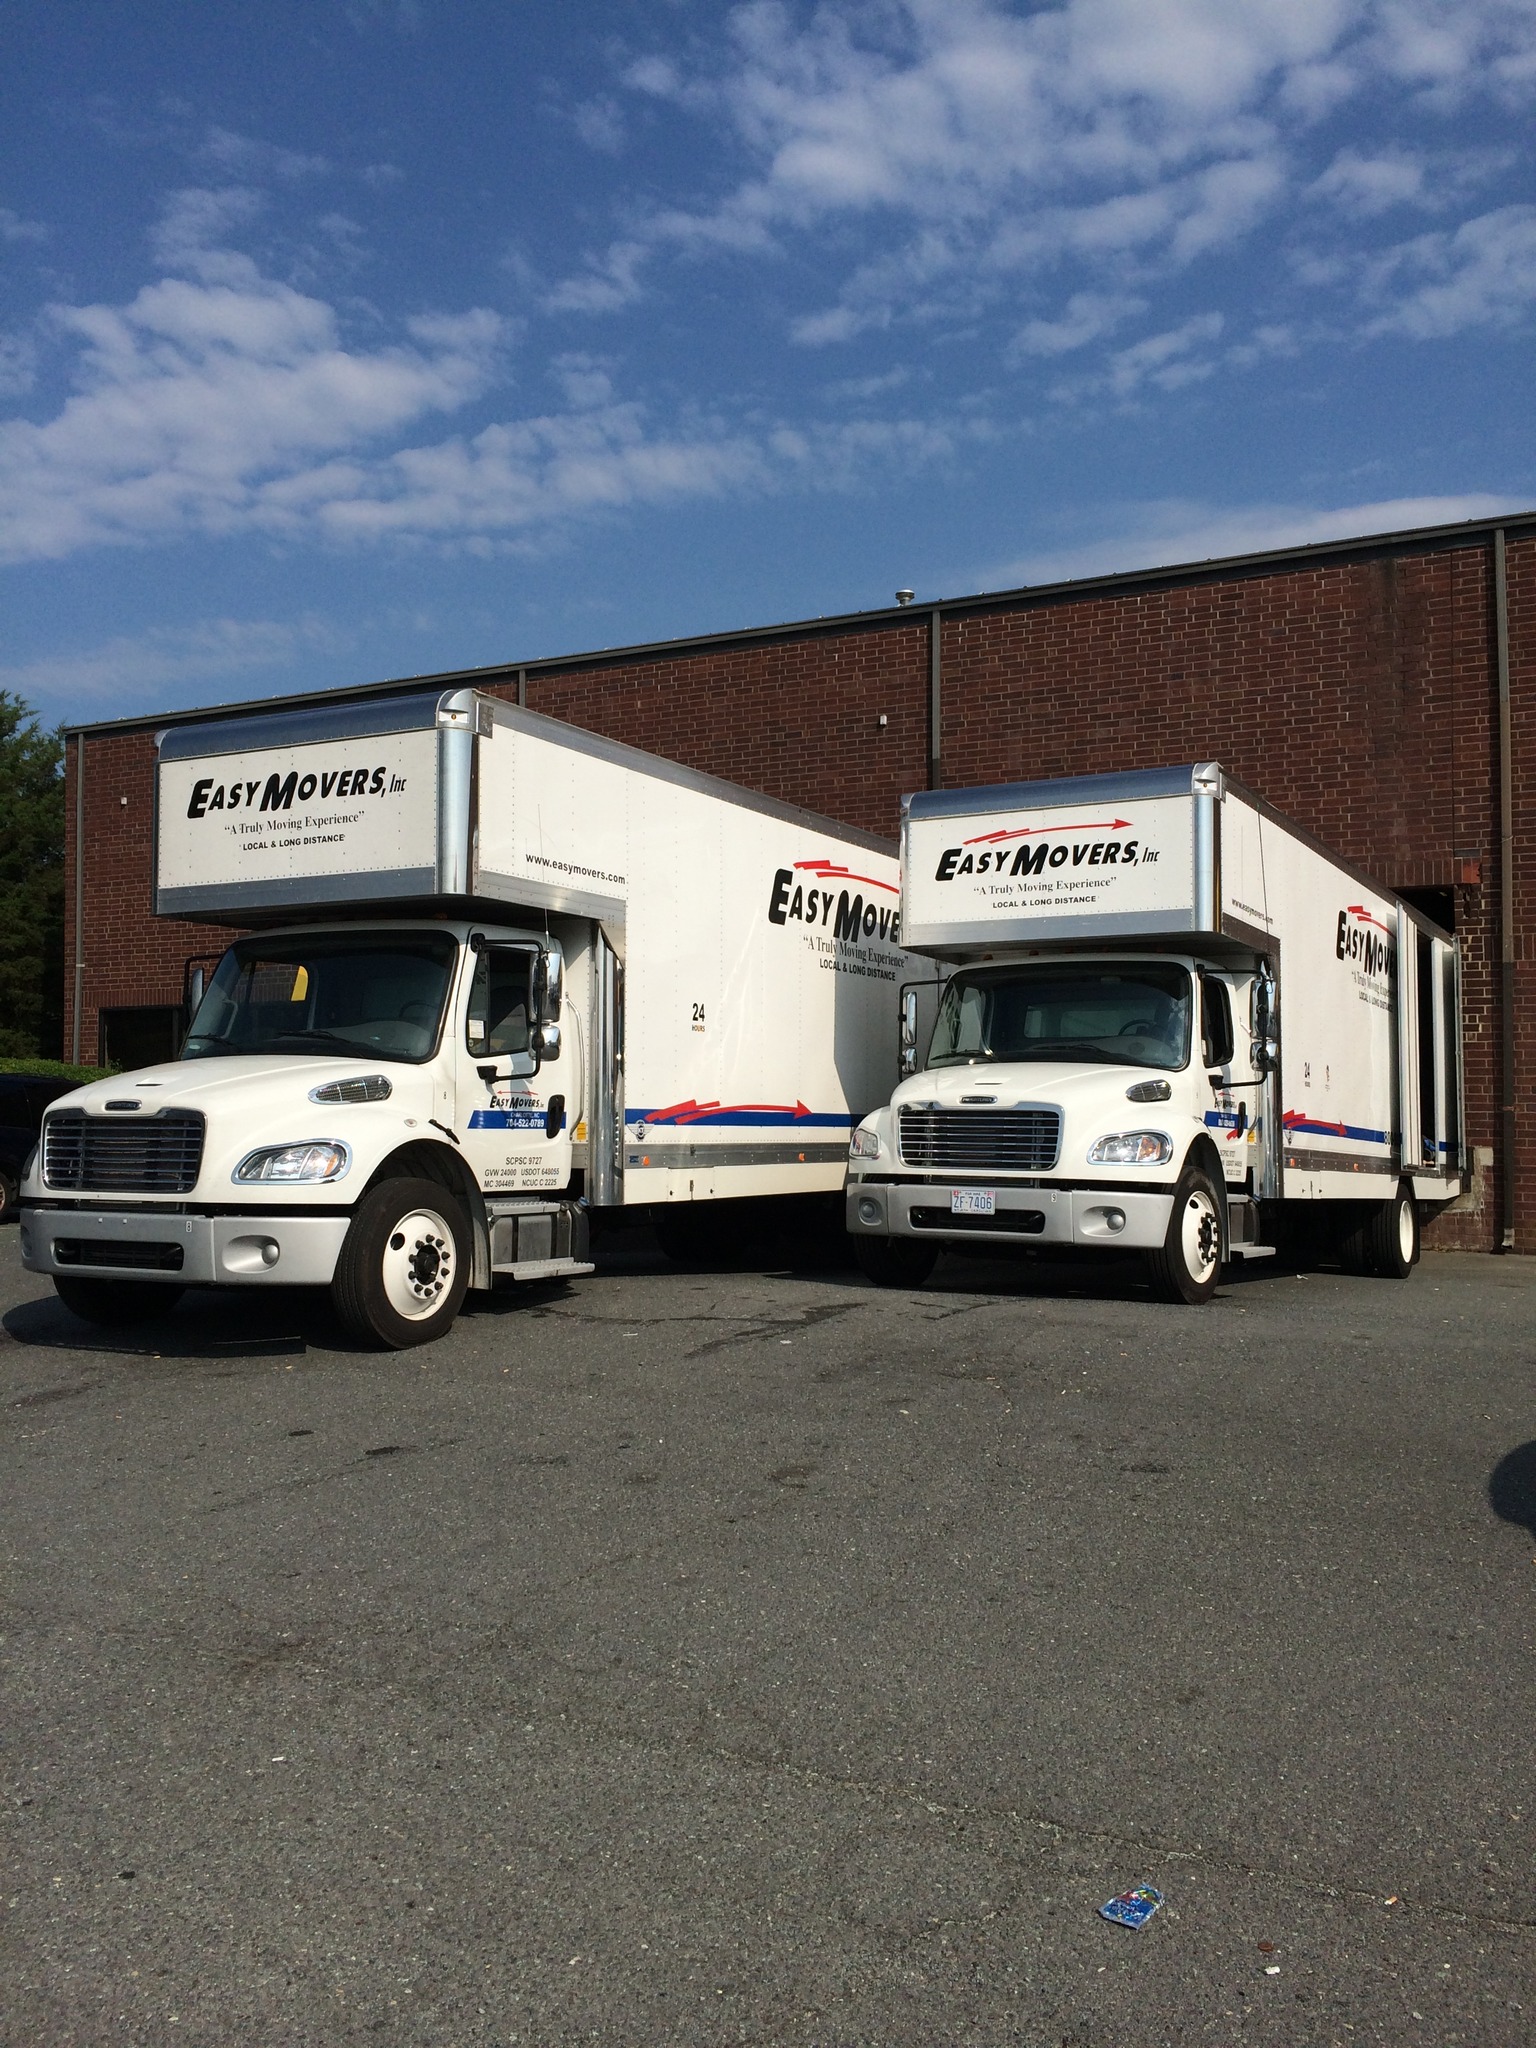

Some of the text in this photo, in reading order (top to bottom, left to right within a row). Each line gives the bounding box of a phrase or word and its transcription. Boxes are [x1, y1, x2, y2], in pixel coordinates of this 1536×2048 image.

[389, 774, 407, 793] Inc
[240, 821, 264, 835] Truly
[266, 819, 303, 831] Moving
[243, 833, 346, 851] LOCAL & LONG DISTANCE
[1142, 847, 1160, 863] Inc
[525, 853, 626, 885] www.easymovers.com
[989, 884, 1014, 896] Truly
[1017, 882, 1053, 892] Moving
[992, 900, 1018, 909] LOCAL
[1030, 898, 1052, 907] LONG
[1054, 895, 1097, 905] DISTANCE
[816, 936, 838, 957] Truly
[839, 941, 867, 964] Moving
[819, 958, 896, 982] LOCAL & LONG DISTANCE
[692, 1002, 706, 1022] 24
[505, 1118, 545, 1128] 704-522-0789
[505, 1156, 543, 1166] SCPSC 9727
[484, 1168, 499, 1177] GVW
[520, 1167, 540, 1176] USDOT
[484, 1180, 494, 1188] MC
[521, 1178, 538, 1187] NCUC
[544, 1178, 557, 1186] 2225
